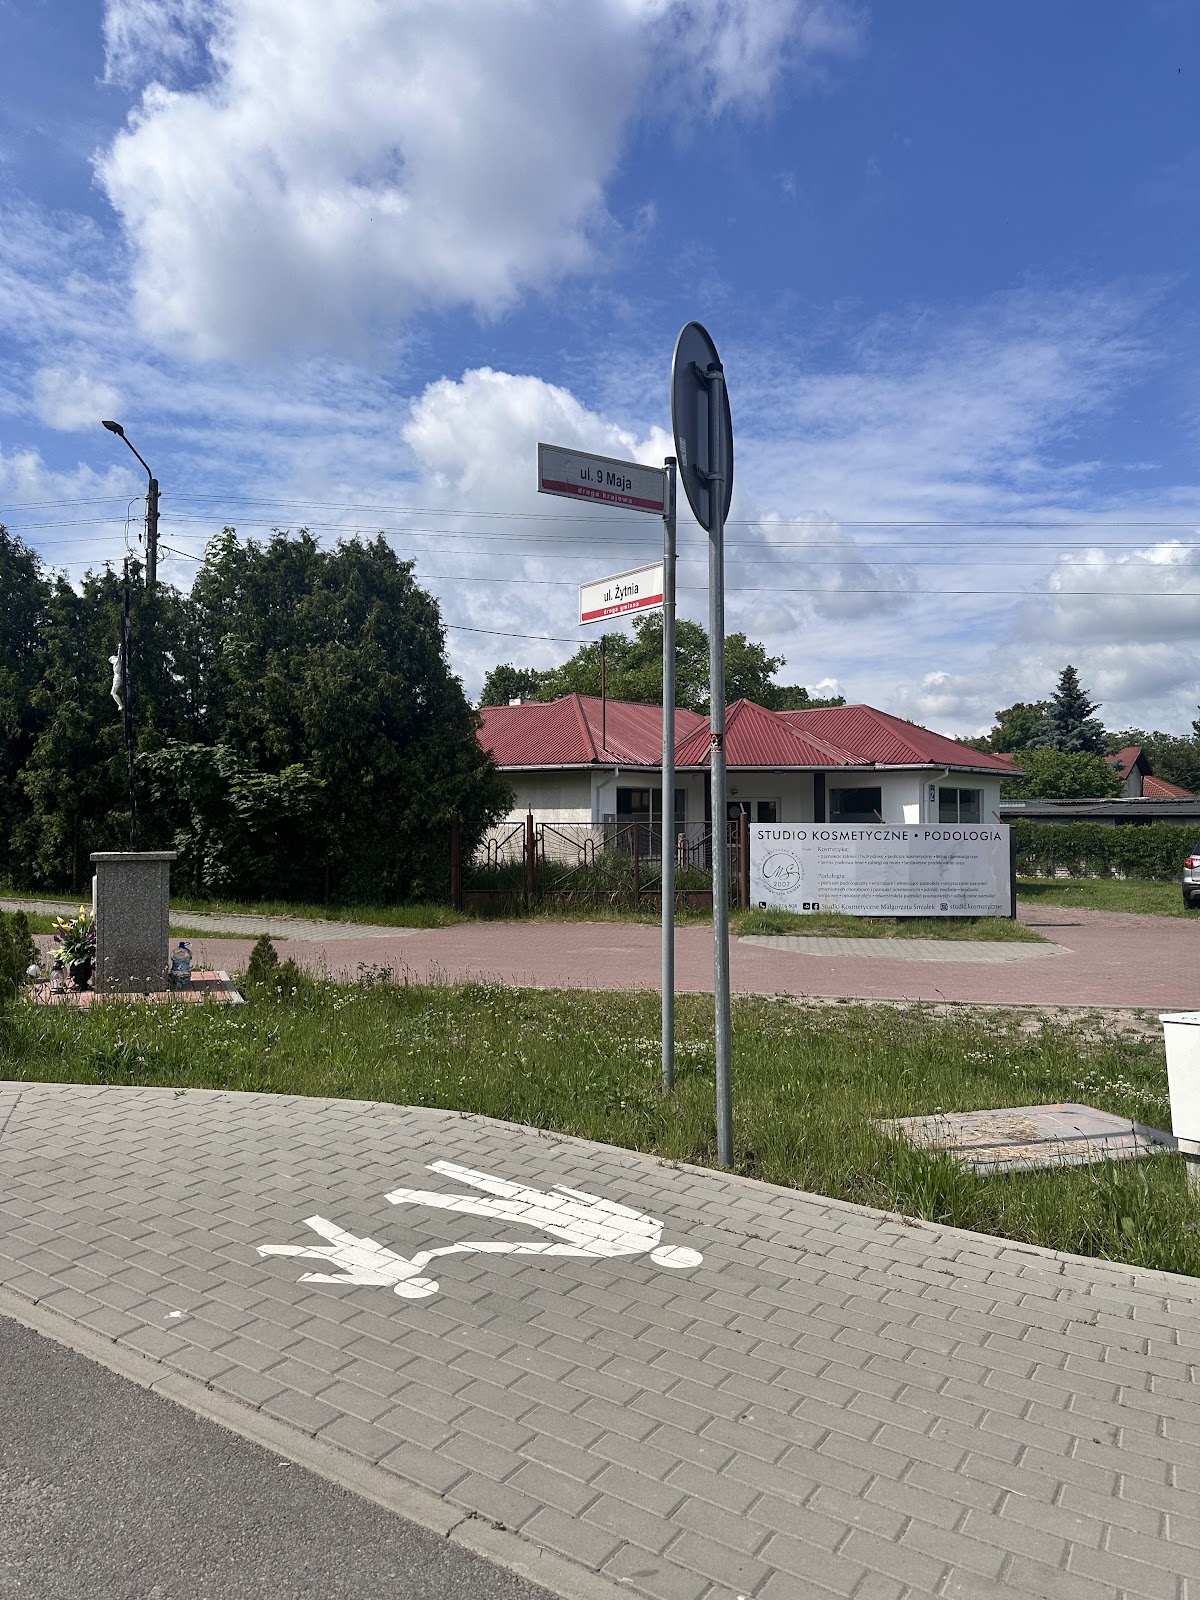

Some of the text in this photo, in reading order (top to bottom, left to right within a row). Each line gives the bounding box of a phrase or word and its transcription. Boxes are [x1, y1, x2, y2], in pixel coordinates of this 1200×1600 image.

[580, 467, 632, 491] ul. 9 Maja
[577, 487, 633, 504] droga krajowa
[603, 583, 639, 602] ul. Żytnia
[603, 601, 640, 615] droga gminna
[757, 830, 1002, 841] STUDIO KOSMETYCZNE PODOLOGIA
